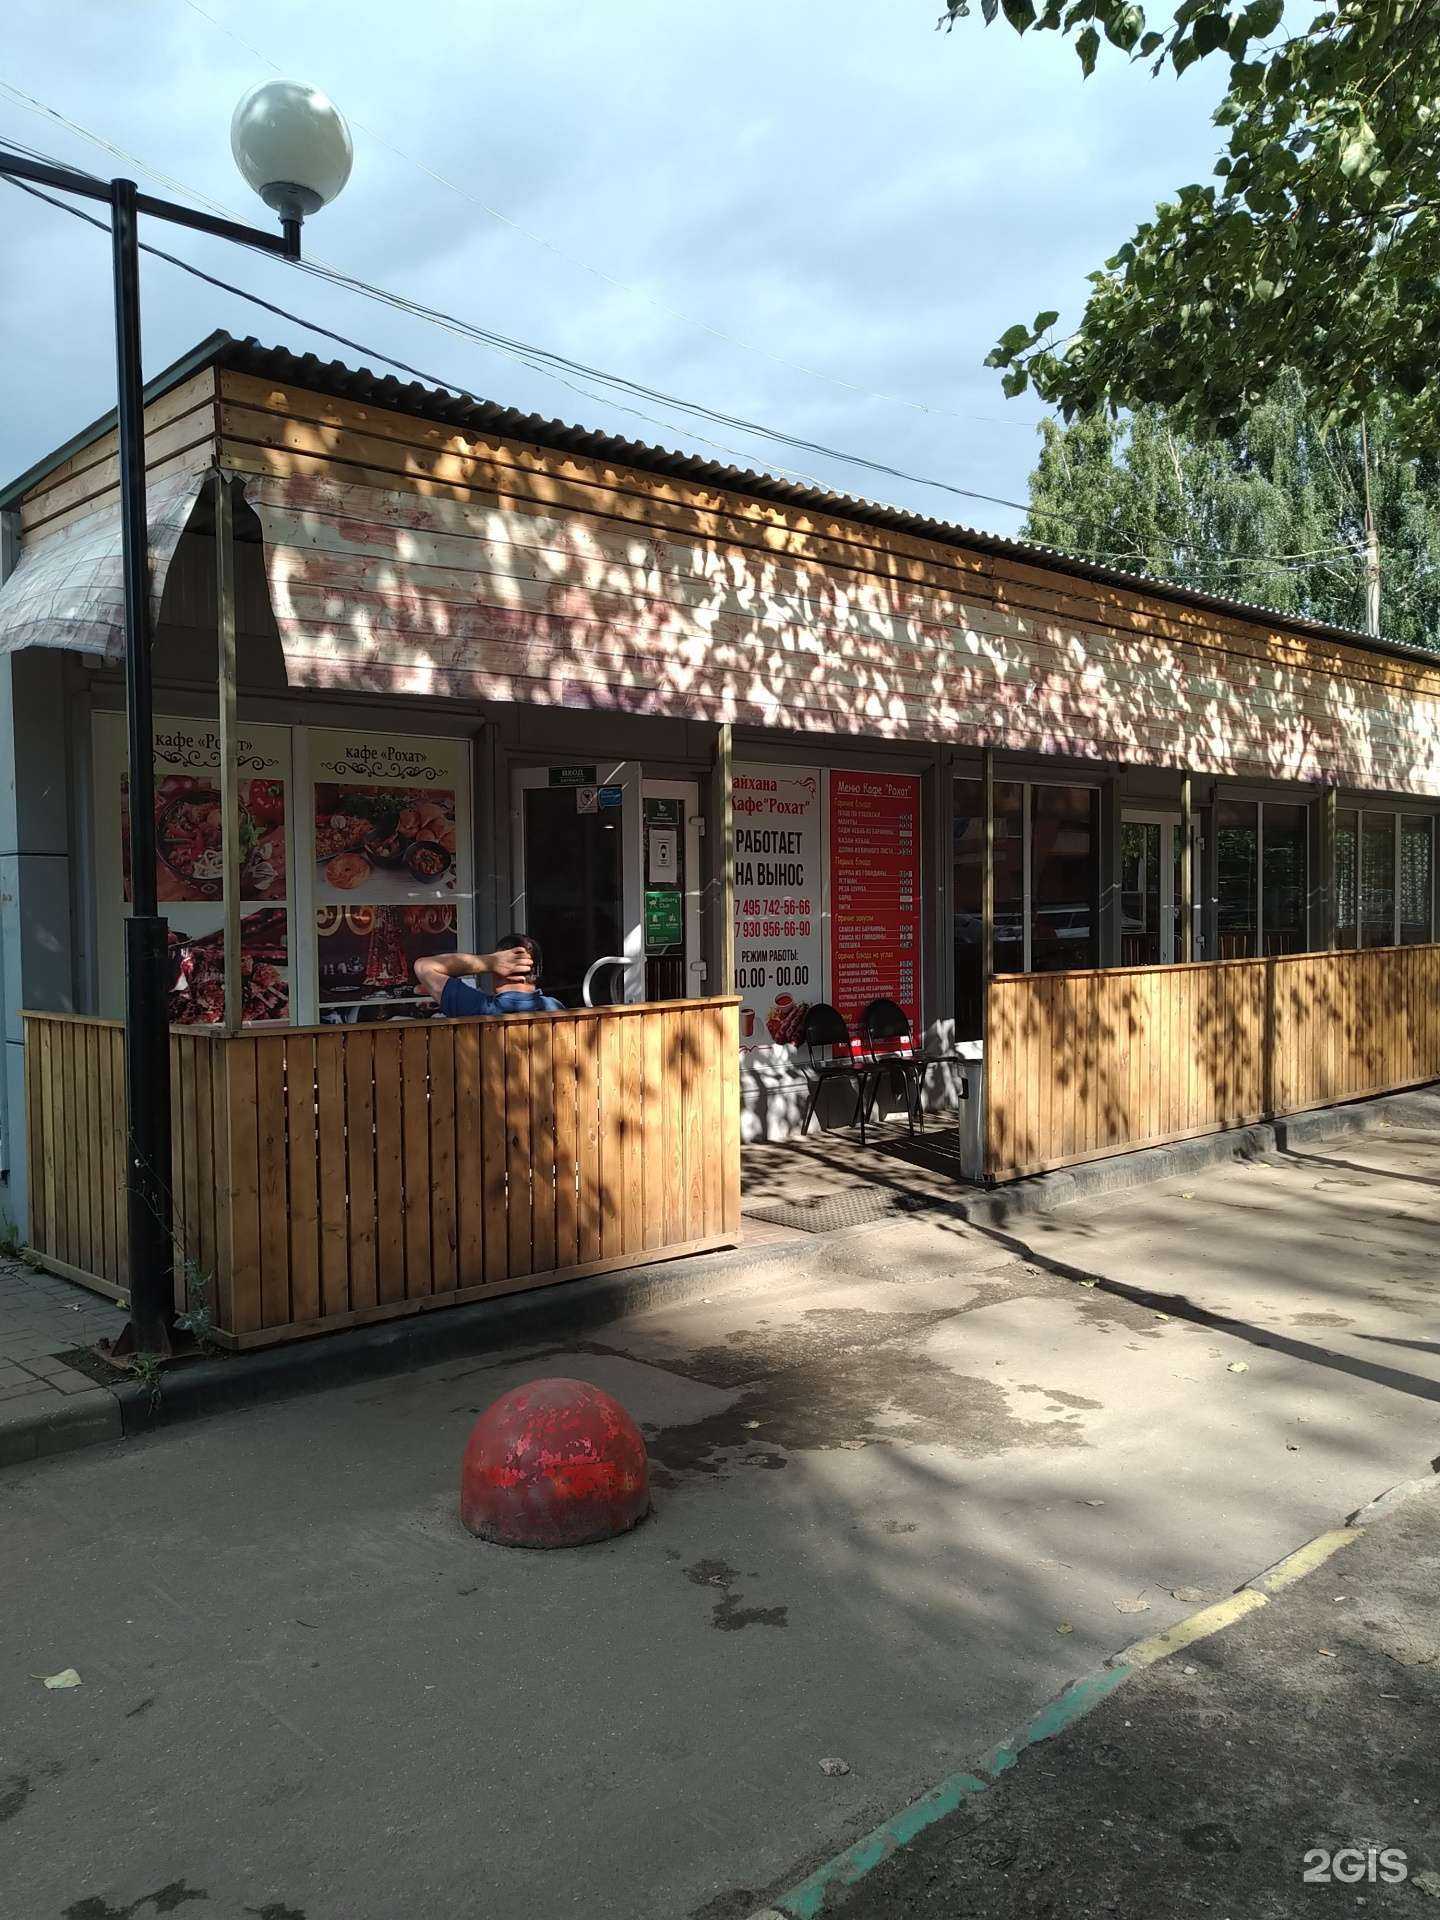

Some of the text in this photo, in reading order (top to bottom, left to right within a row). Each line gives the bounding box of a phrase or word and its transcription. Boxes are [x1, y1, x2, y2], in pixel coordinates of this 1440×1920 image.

[155, 731, 253, 752] кафе «Рот»
[345, 744, 427, 764] кафе «Рохат»
[732, 774, 777, 792] айхана
[837, 780, 861, 794] Меню
[735, 829, 803, 855] РАБОТАЕТ
[735, 862, 805, 887] НА ВЫНОС
[743, 898, 761, 916] 495
[763, 899, 811, 916] 742-56-66
[743, 921, 761, 938] 930
[763, 920, 811, 938] 956-66-90
[741, 948, 799, 963] РЕЖИМ РАБОТЫ:
[776, 965, 809, 987] 00.00
